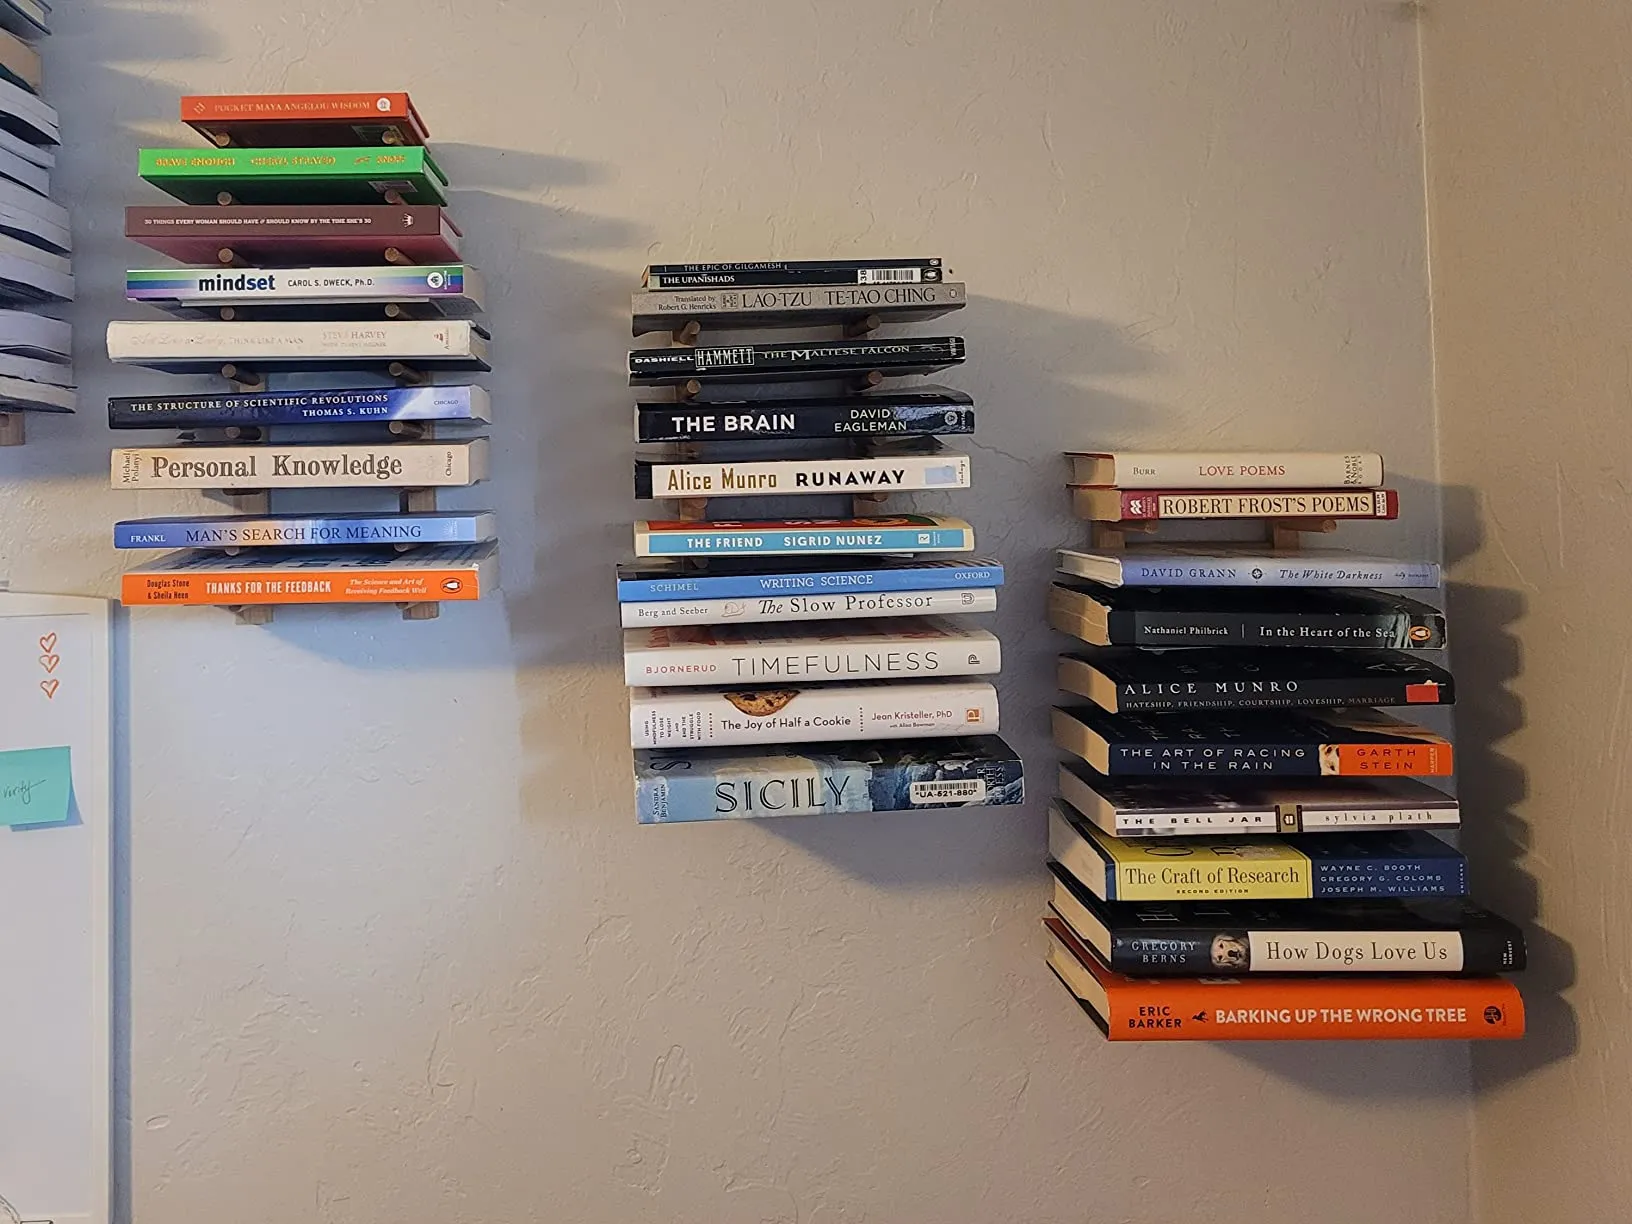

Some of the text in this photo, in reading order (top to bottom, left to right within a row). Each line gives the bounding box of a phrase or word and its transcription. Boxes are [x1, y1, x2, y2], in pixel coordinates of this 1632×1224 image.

[214, 102, 370, 112] POCKET MAYA ANGELOU WISDOM
[684, 264, 700, 272] THE
[734, 262, 782, 270] GILGAMESH
[198, 274, 375, 291] mindset CAROL DWECK, Ph.D.
[662, 275, 735, 284] THE UPANISHADS
[742, 288, 936, 308] LAO-TZU TE-TAO CHING
[689, 302, 716, 310] Henricks
[352, 331, 387, 339] HARVEY
[634, 356, 694, 364] DASHIELL
[697, 348, 752, 366] HAMMETT
[860, 346, 910, 354] FALCON
[131, 394, 388, 412] THE STRUCTURE OF SCIENTIFIC REVOLUTIONS
[302, 408, 344, 416] THOMAS
[850, 408, 891, 419] DAVID
[672, 414, 795, 432] THE BRAIN
[834, 420, 907, 432] EAGLEMAN
[122, 450, 130, 483] Michael
[151, 454, 402, 480] Personal Knowledge
[1133, 466, 1286, 476] BURR LOVE POEMS
[668, 468, 904, 490] Alice Munro RUNAWAY
[1163, 498, 1233, 515] ROBERT
[1239, 498, 1306, 514] FROST'S
[1312, 496, 1370, 512] POEMS
[130, 535, 166, 543] FRANKL
[186, 526, 421, 542] MAN'S SEARCH FOR MEANING
[687, 534, 882, 548] THE FRIEND SIGRID NUNEZ
[1142, 568, 1382, 580] DAVID GRANN The White Darkness
[146, 580, 190, 588] Douglas Stone
[206, 581, 332, 594] THANKS FOR THE FEEDBACK
[650, 572, 990, 592] SCHIMEL WRITING SCIENCE OXFORD
[154, 592, 172, 600] Sheila
[638, 594, 932, 618] Berg and Seeber The Slow Professor
[1144, 626, 1396, 638] Nathaniel Philbrick the Heart the Sea
[646, 652, 938, 676] BJORNERUD TIMEFULNESS
[1124, 680, 1298, 695] ALICE MUNRO
[1178, 700, 1235, 708] FRIENDSHIP,
[1298, 698, 1344, 706] LOVESHIP,
[894, 711, 934, 720] Kristeller,
[936, 710, 952, 718] PhD
[721, 716, 851, 731] The Joy Half Cookie
[1120, 748, 1305, 757] THE ART OF RACING
[1356, 748, 1416, 756] GARTH
[1153, 762, 1273, 770] IN THE RAIN
[1360, 762, 1412, 770] STEIN
[715, 776, 850, 812] SICILY
[1229, 816, 1262, 824] JAR
[1326, 813, 1376, 824] sylvia
[1389, 812, 1432, 823] plath
[1126, 866, 1300, 885] The Craft of Research
[1131, 942, 1196, 951] GREGORY
[1142, 954, 1186, 964] BERNS
[1266, 942, 1448, 966] How Dogs Love Us
[1140, 1006, 1170, 1016] ERIC
[1216, 1008, 1466, 1024] BARKING UP THE WRONG TREE
[1128, 1018, 1182, 1028] BARKER
